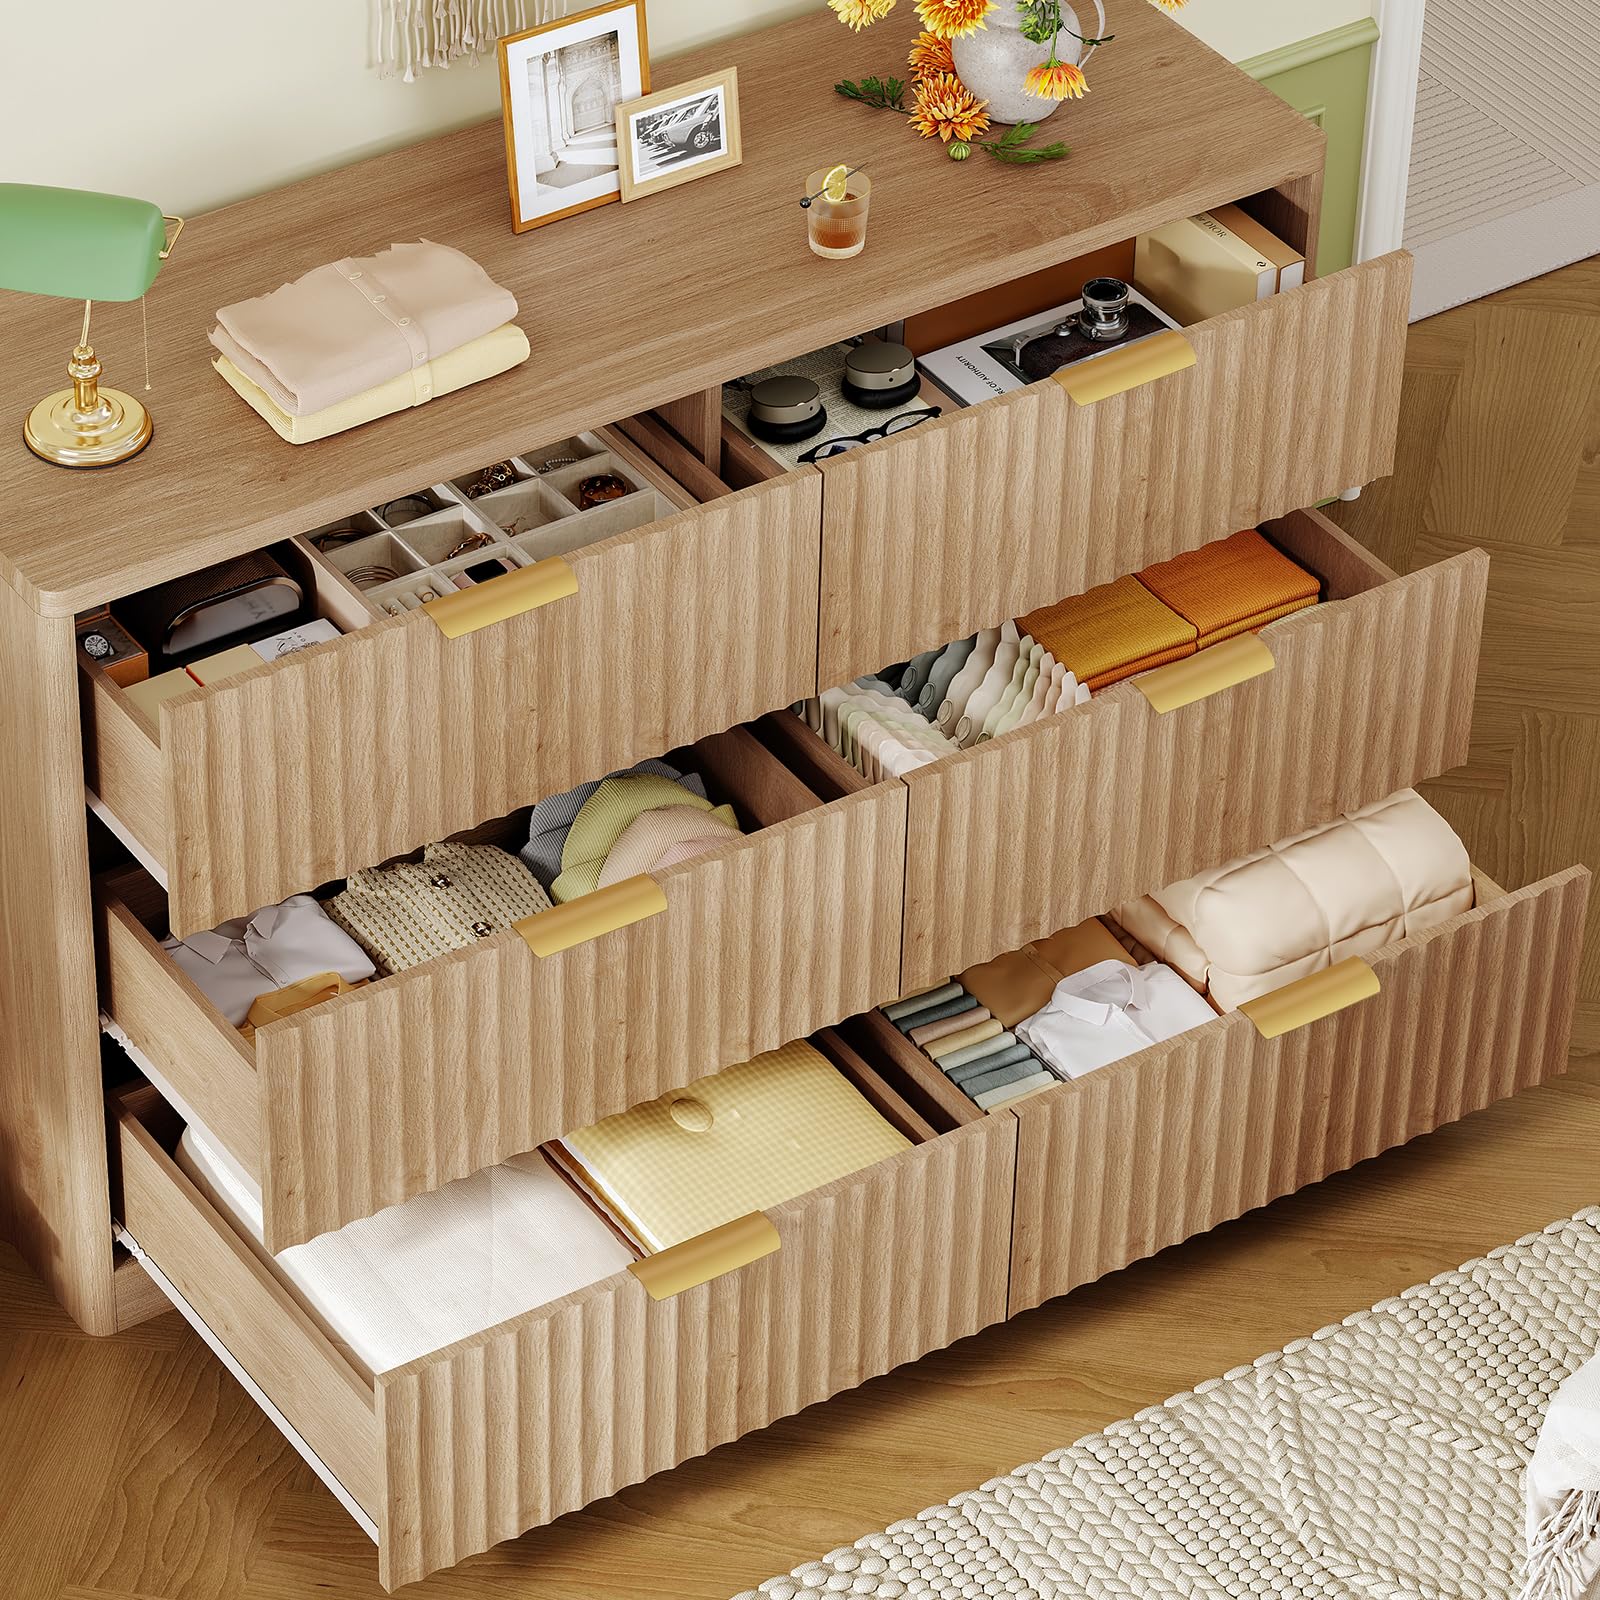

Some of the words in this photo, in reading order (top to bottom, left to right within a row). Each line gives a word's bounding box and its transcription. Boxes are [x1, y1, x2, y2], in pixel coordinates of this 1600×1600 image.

[1203, 220, 1227, 238] DIOR
[956, 355, 990, 381] AUTHORITY
[986, 380, 997, 389] OF
